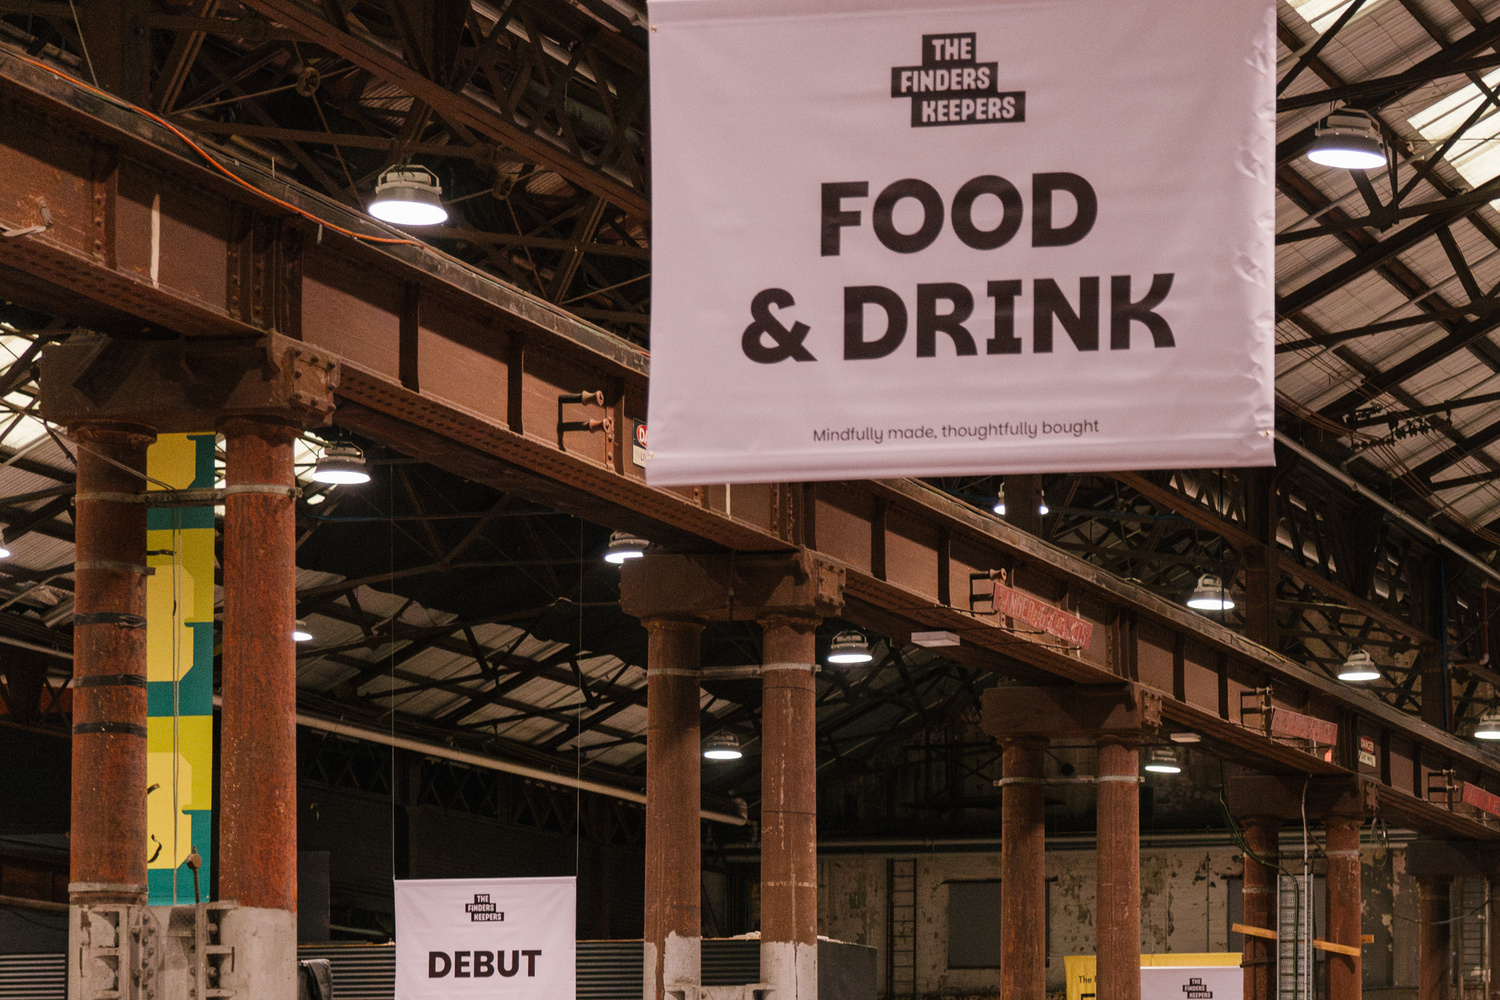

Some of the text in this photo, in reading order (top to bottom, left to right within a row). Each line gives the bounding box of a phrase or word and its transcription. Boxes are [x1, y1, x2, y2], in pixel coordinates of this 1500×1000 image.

[931, 37, 973, 61] THE
[900, 67, 991, 93] FINDERS
[921, 96, 1016, 123] KEEPERS
[821, 172, 1098, 257] FOOD
[741, 273, 1176, 364] & DRINK
[813, 418, 1100, 445] Mindfully made, thoughtfully bought
[467, 904, 495, 912] FINDERS
[476, 895, 490, 903] THE
[473, 913, 502, 921] KEEPERS
[428, 949, 543, 979] DEBUT
